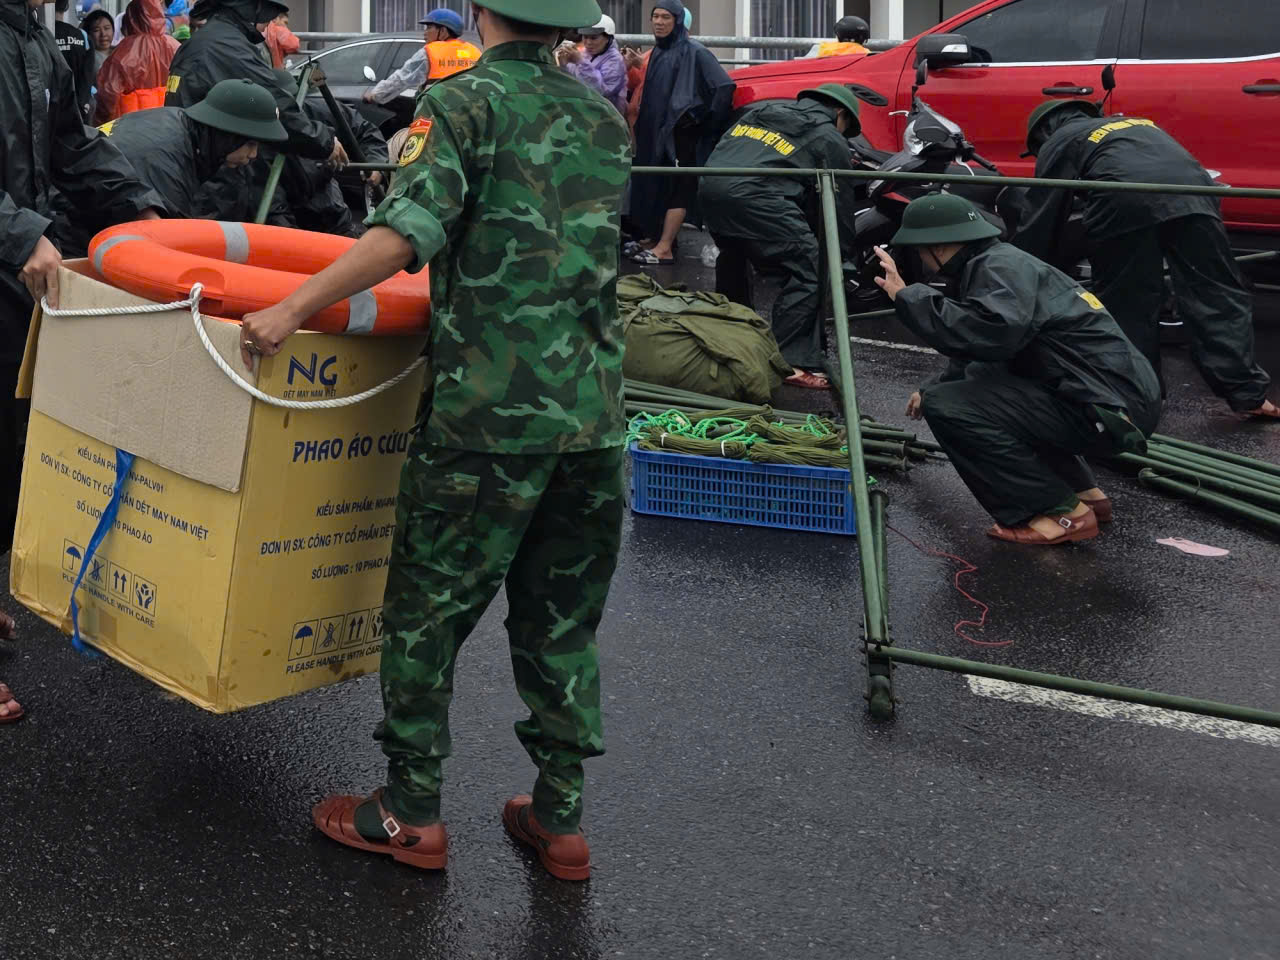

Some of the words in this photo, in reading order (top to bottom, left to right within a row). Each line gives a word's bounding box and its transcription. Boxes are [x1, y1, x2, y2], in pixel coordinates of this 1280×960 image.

[67, 36, 84, 46] Dior
[293, 438, 344, 464] PHAO
[348, 432, 373, 460] ÁO
[378, 428, 408, 455] CỨU
[40, 452, 54, 467] ĐƠN
[54, 460, 61, 473] VỊ
[72, 469, 92, 487] CÔNG
[91, 479, 101, 492] TY
[120, 490, 134, 508] HẦN
[151, 507, 169, 524] MAY
[170, 515, 188, 532] NAM
[188, 523, 208, 541] VIỆT
[76, 500, 86, 512] SỐ
[86, 506, 104, 521] LƯỢN
[122, 522, 141, 539] PHAO
[142, 533, 153, 544] ÁO
[261, 540, 281, 555] ĐƠN
[283, 540, 291, 555] VỊ
[292, 538, 305, 551] SX:
[307, 533, 331, 549] CÔNG
[333, 532, 345, 545] TY
[344, 525, 358, 544] CỔ
[312, 563, 323, 580] SỐ
[323, 563, 349, 580] LƯỢNG
[354, 561, 363, 572] 10
[363, 558, 383, 571] PHAO
[88, 586, 115, 606] HANDLE
[115, 601, 134, 617] WITH
[135, 613, 155, 628] CARE
[286, 659, 315, 674] PLEASE
[316, 653, 345, 667] HANDLE
[346, 647, 365, 661] WITH
